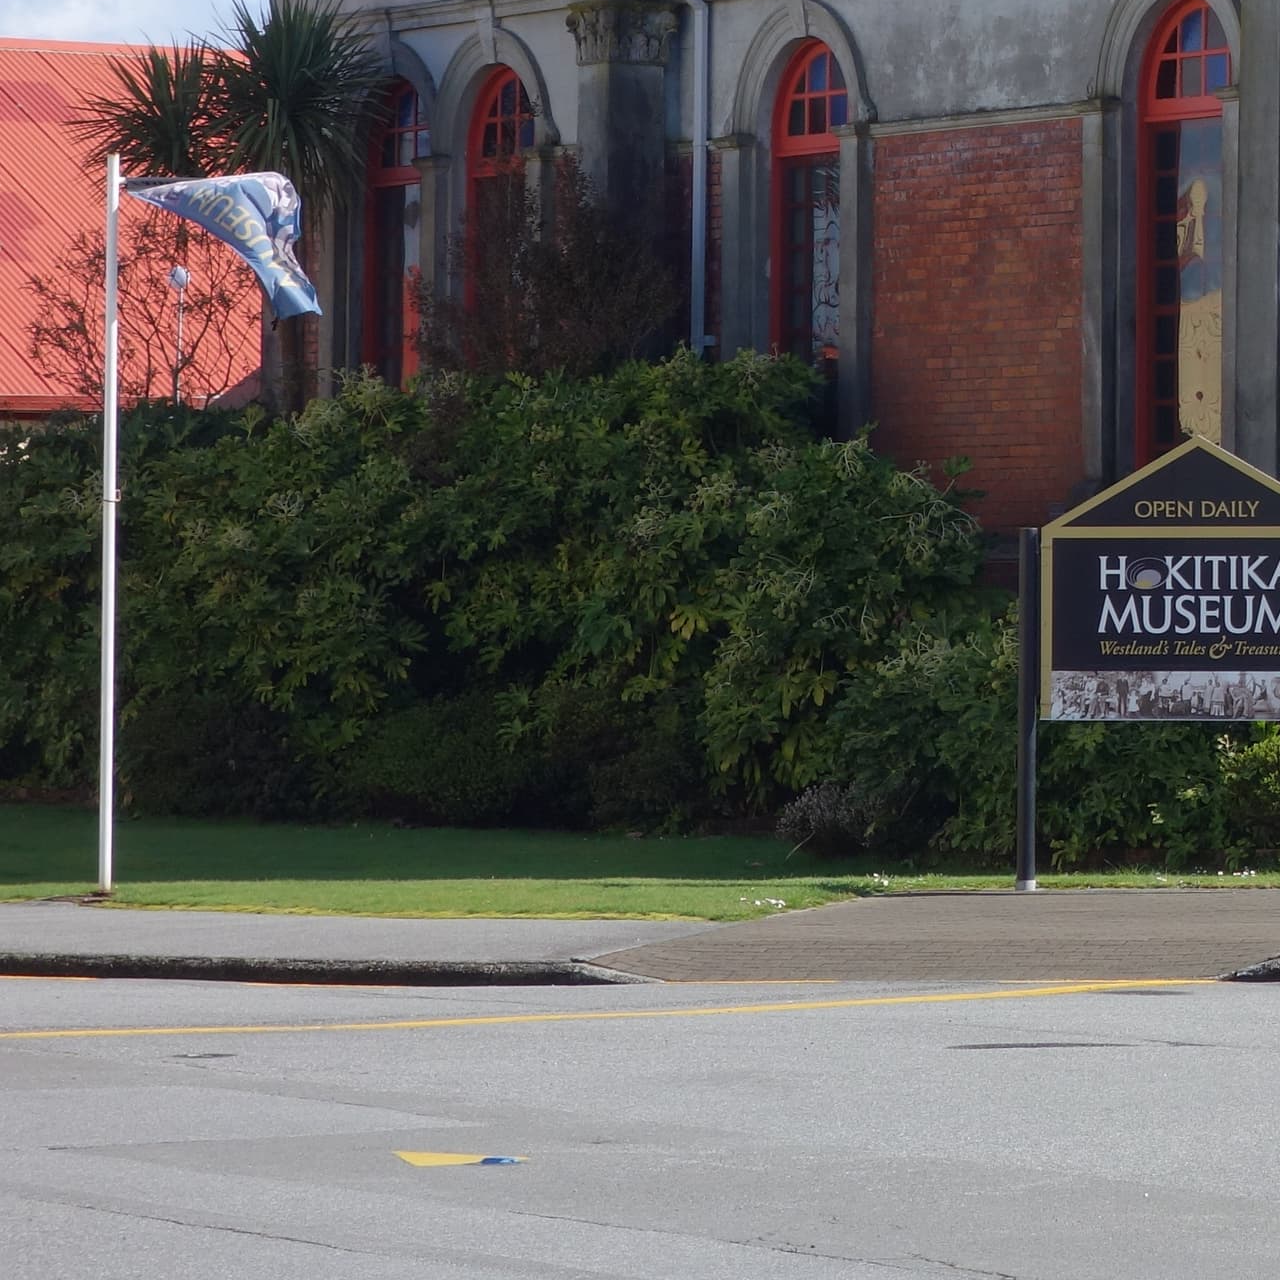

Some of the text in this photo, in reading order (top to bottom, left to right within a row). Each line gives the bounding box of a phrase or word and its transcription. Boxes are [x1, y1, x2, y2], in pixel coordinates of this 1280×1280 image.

[1134, 500, 1260, 518] OPEN DAILY
[1099, 640, 1170, 656] Westland's
[1174, 640, 1206, 656] Tales
[1209, 635, 1233, 660] &
